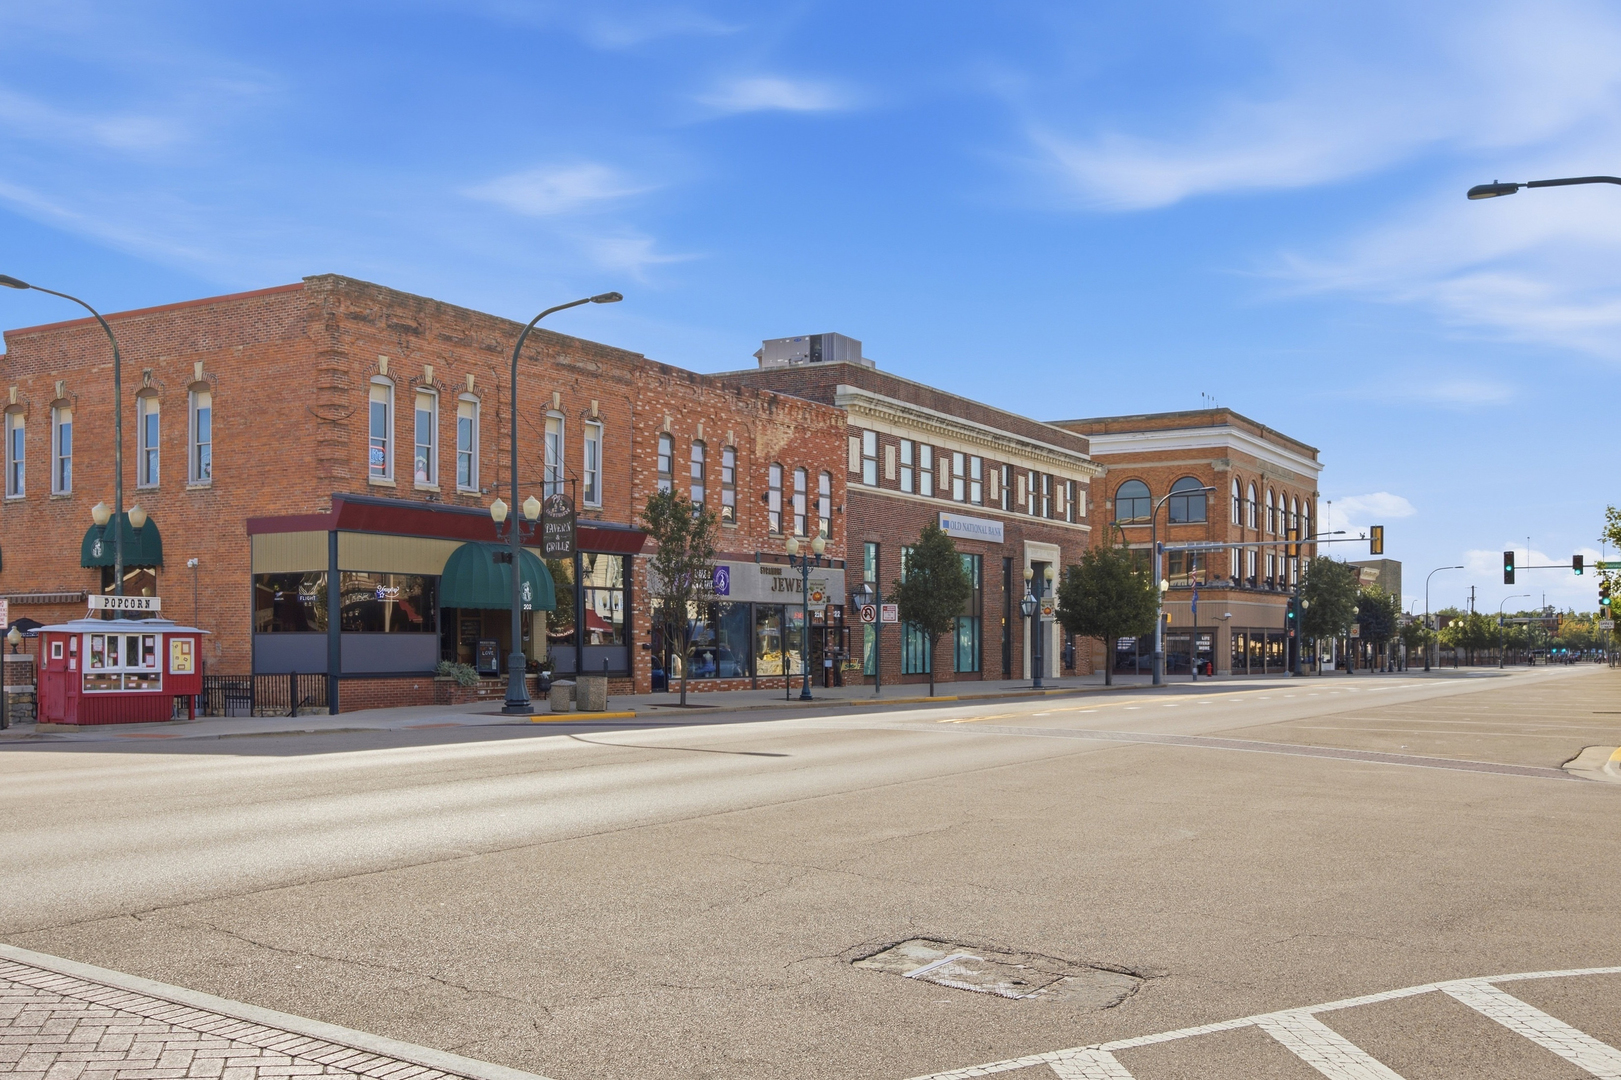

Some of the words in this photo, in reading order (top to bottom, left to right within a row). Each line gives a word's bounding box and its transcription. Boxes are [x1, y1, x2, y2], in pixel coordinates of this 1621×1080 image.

[545, 521, 571, 534] TAVERN
[950, 520, 962, 531] OLD
[962, 522, 988, 535] NATIONAL
[988, 526, 1002, 537] BANK
[546, 540, 570, 553] GRILLE
[760, 566, 783, 576] SYCAMORE
[771, 577, 805, 593] JEWE
[104, 598, 151, 609] POPCORN
